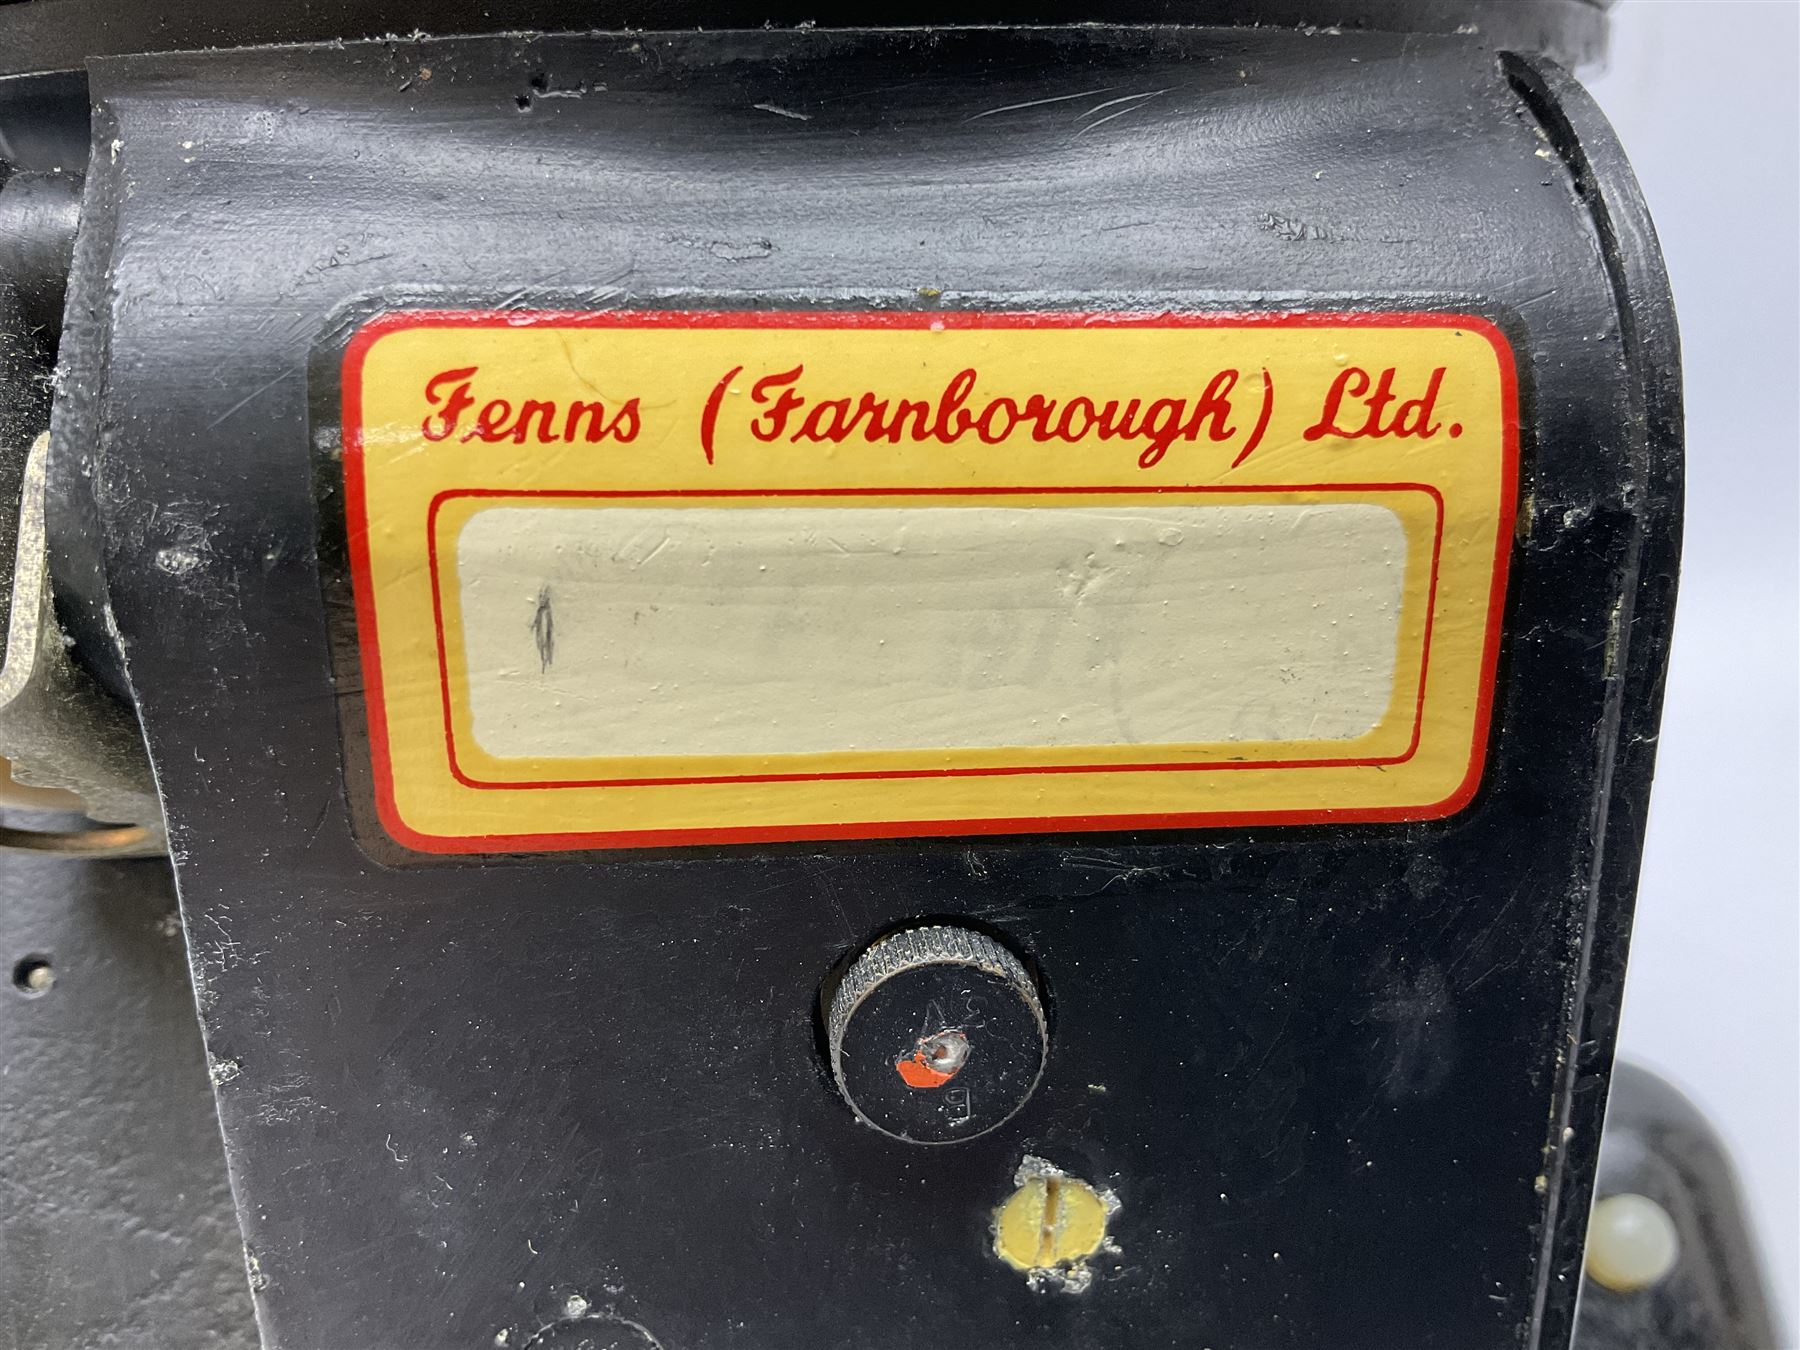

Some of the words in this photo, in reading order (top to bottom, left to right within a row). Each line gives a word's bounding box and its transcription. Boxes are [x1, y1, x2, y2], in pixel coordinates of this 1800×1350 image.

[422, 366, 642, 445] Fenns
[701, 365, 1275, 469] (Farnborough)
[1303, 366, 1464, 443] Ltd.
